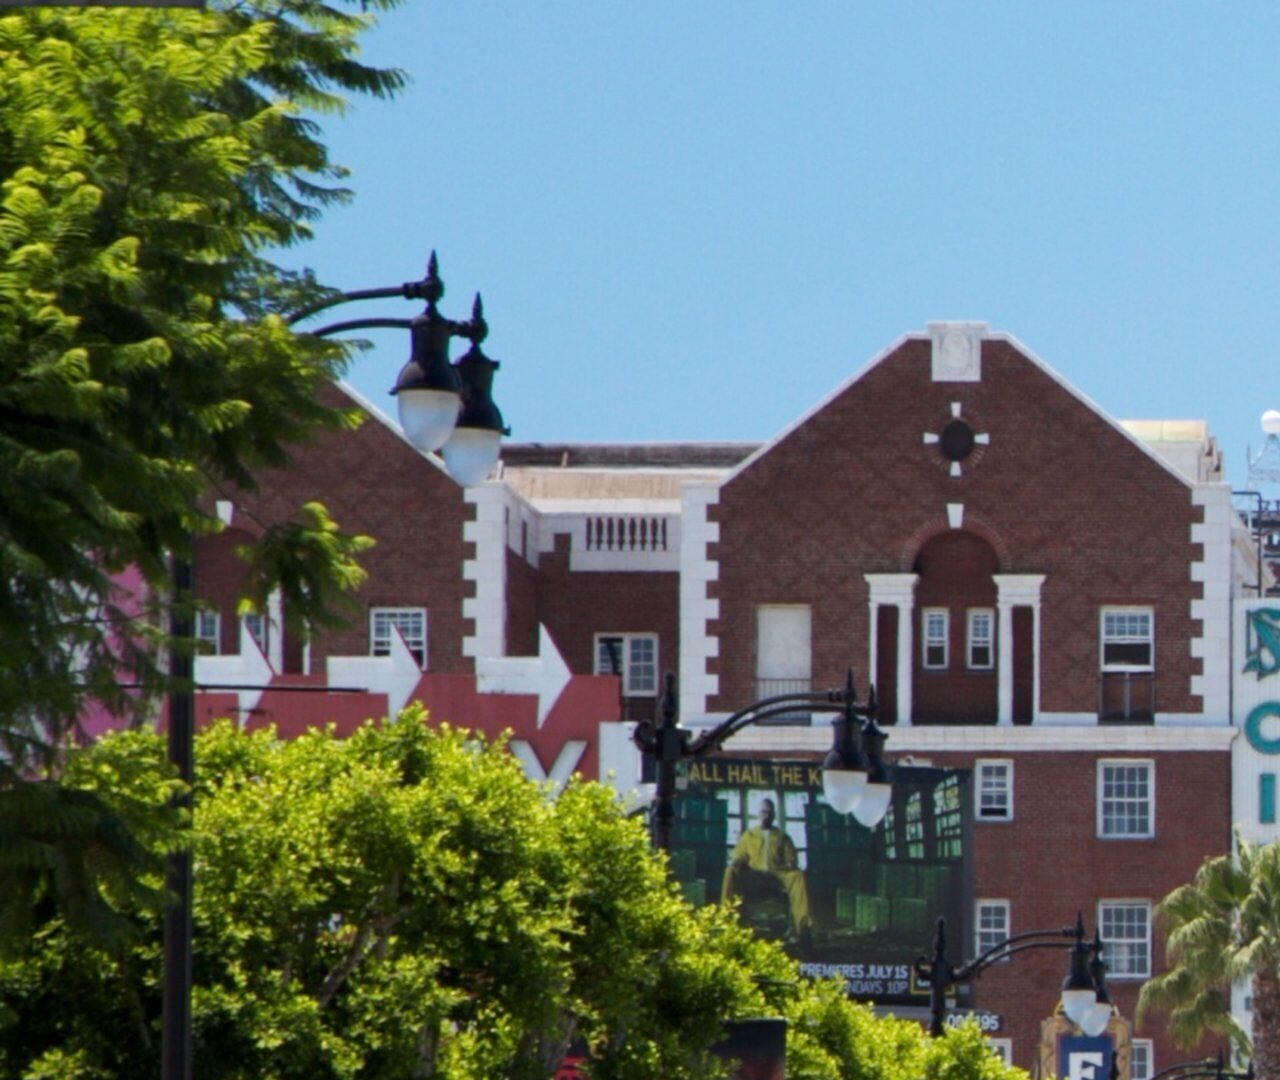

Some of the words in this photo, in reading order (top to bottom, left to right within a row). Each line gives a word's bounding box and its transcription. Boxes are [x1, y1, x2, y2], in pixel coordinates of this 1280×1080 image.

[689, 764, 723, 784] ALL
[728, 765, 768, 785] HAIL
[772, 766, 802, 785] THE
[865, 964, 895, 978] JULY
[896, 965, 908, 978] 15
